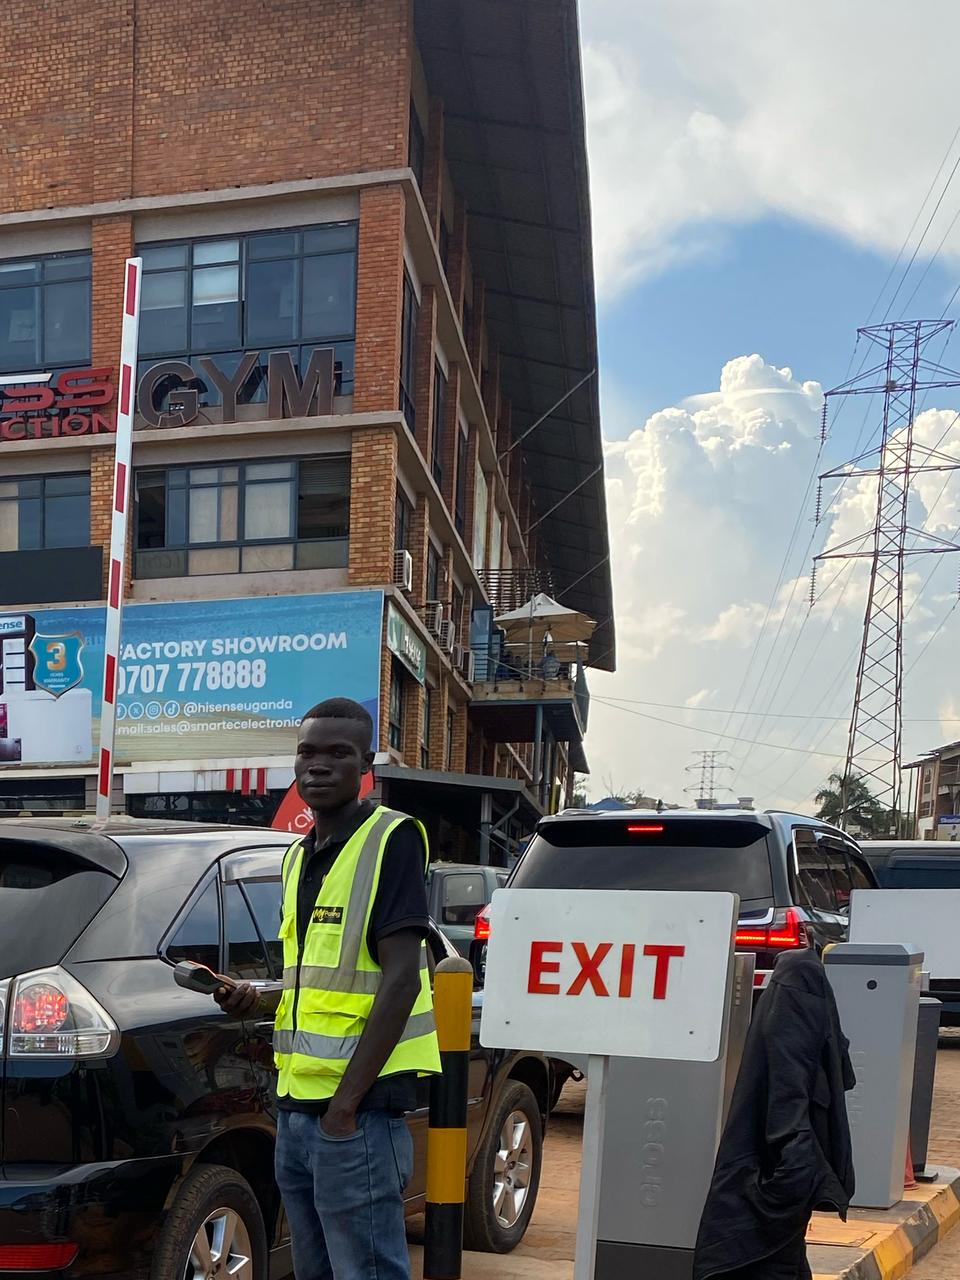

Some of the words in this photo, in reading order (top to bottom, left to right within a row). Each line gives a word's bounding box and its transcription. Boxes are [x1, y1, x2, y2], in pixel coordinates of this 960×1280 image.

[137, 347, 337, 429] GYM
[46, 641, 66, 671] 3
[119, 638, 208, 661] ACTORY
[211, 632, 348, 657] SHOWROOM
[177, 658, 267, 692] 778888
[183, 699, 293, 717] @hisenseuganda
[527, 940, 686, 1000] EXIT
